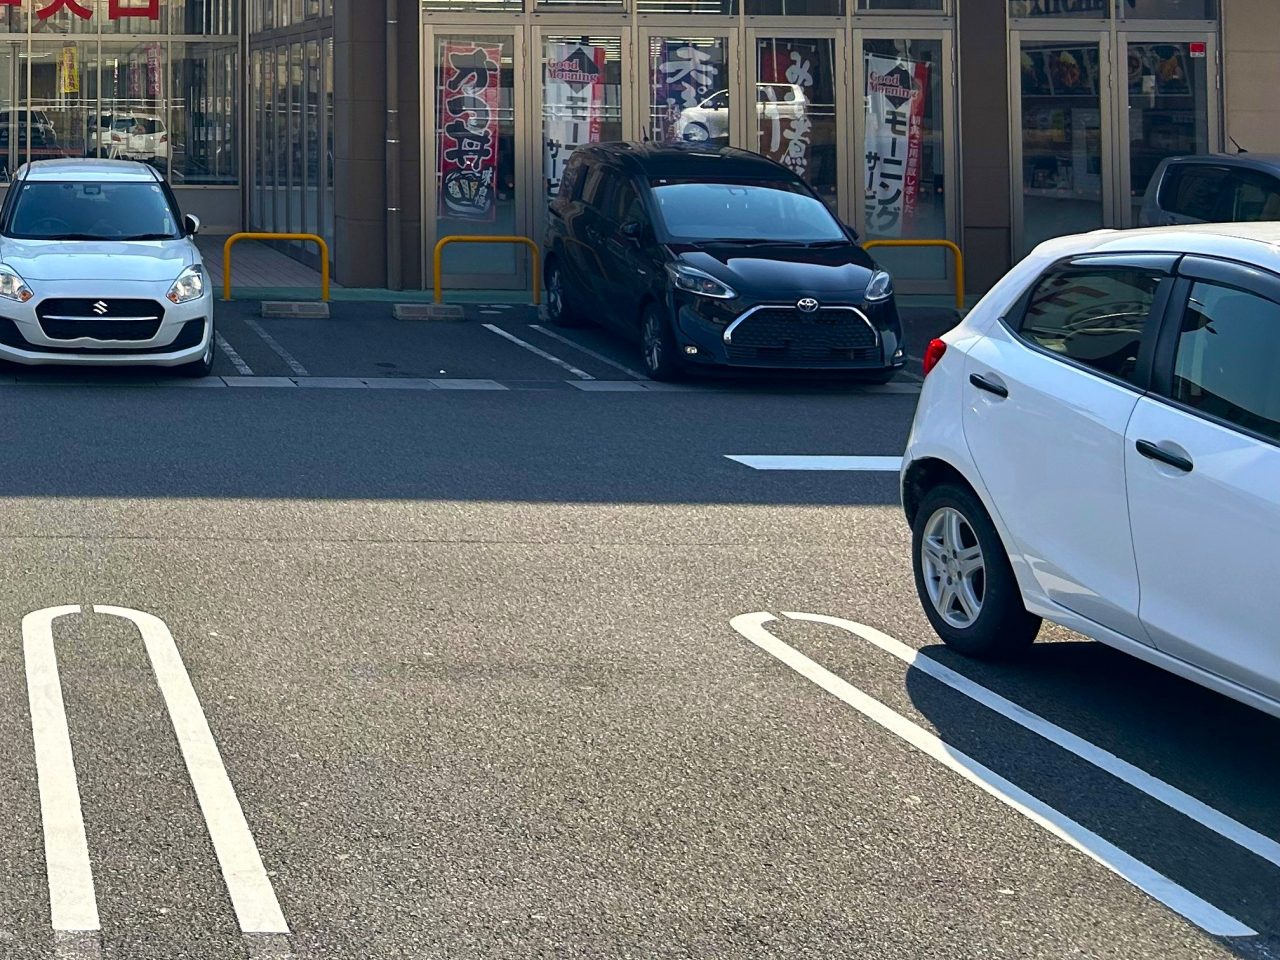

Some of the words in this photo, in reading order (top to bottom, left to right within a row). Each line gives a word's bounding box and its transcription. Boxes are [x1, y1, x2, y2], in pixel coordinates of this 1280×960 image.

[548, 57, 580, 71] Good
[548, 67, 599, 83] Morning
[869, 70, 901, 86] Good
[869, 80, 919, 99] Morning
[876, 110, 907, 232] モーニング
